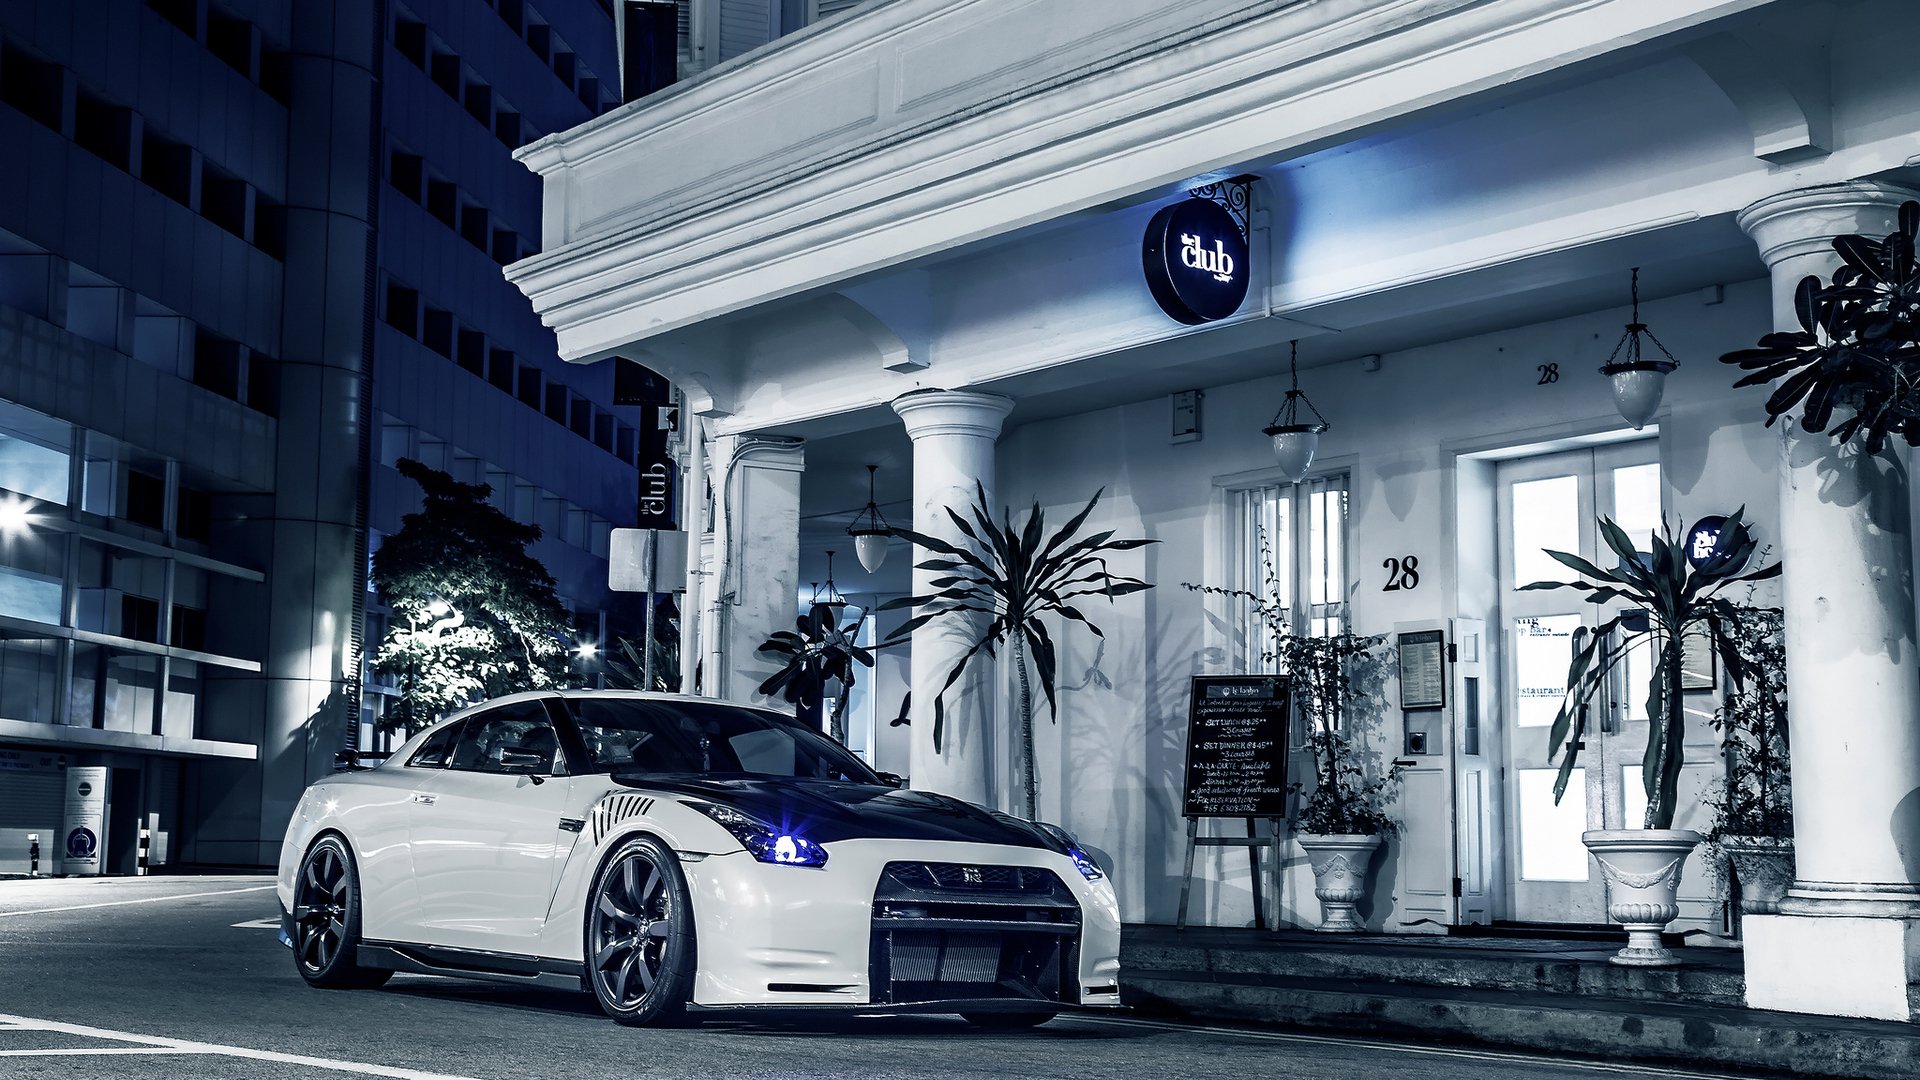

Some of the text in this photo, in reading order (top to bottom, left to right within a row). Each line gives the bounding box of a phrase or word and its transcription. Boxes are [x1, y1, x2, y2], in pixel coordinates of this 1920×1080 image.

[1181, 235, 1234, 275] club
[1537, 363, 1559, 385] 28
[641, 463, 667, 515] club
[1382, 555, 1419, 591] 28
